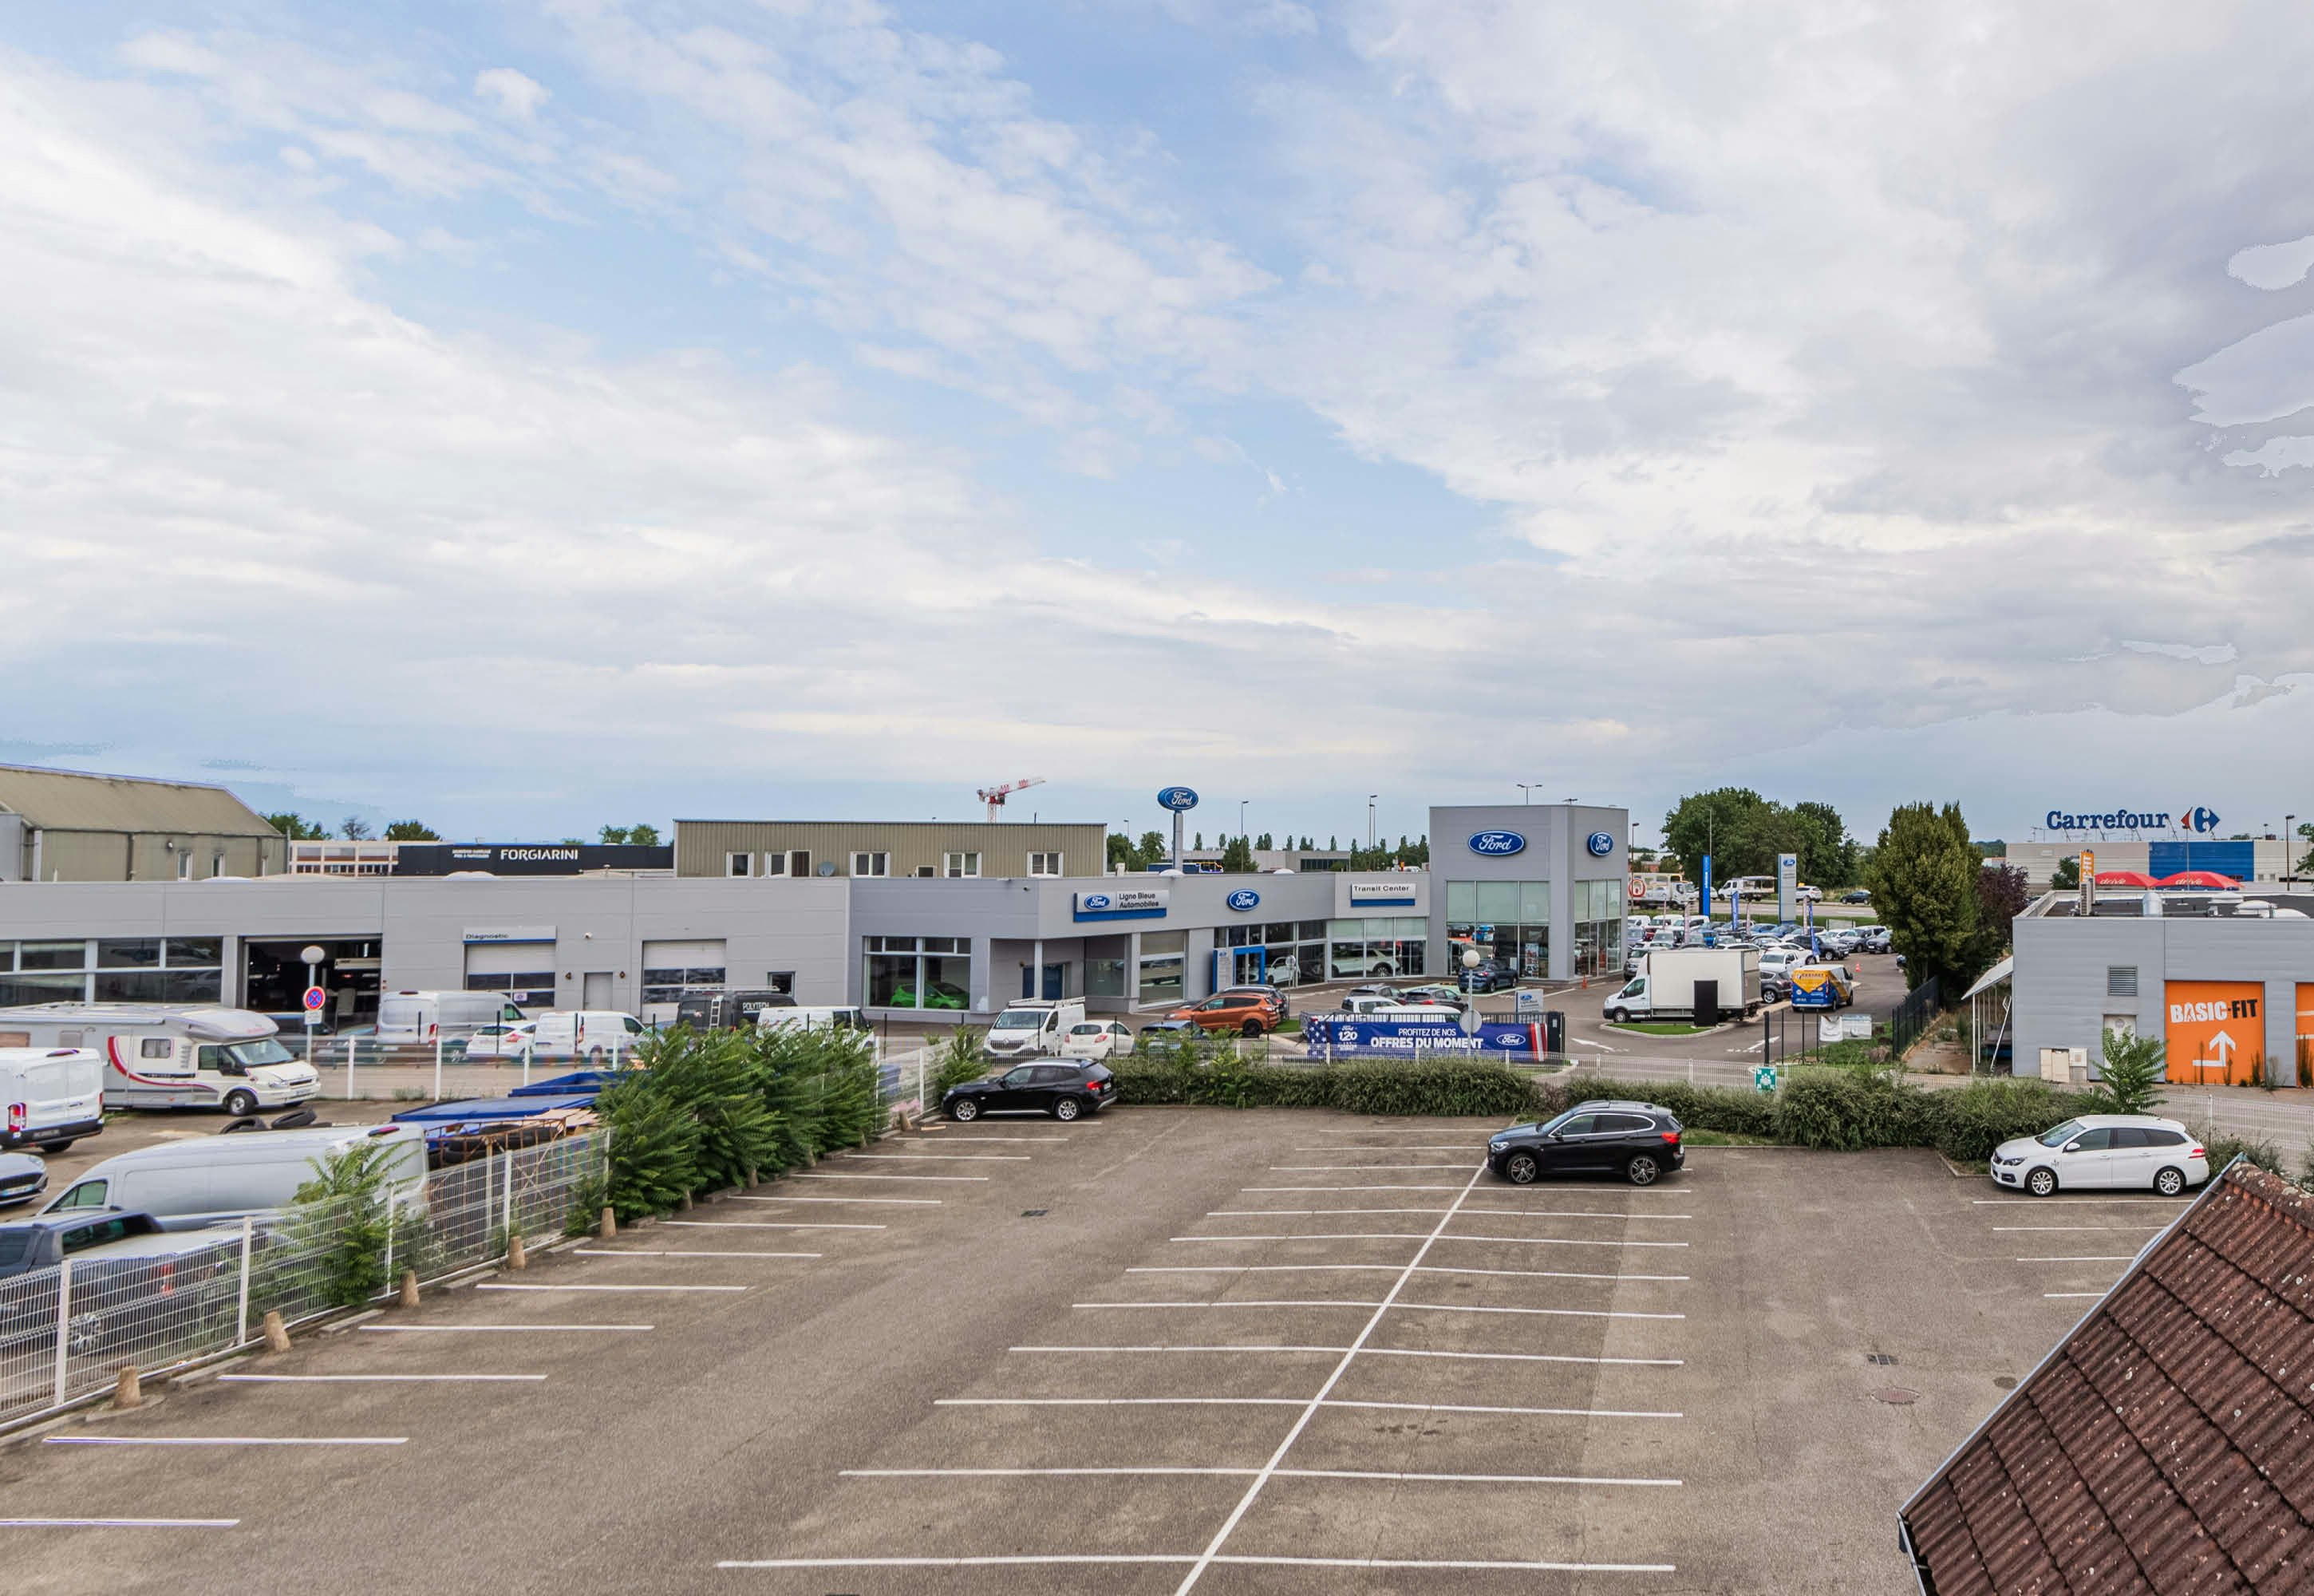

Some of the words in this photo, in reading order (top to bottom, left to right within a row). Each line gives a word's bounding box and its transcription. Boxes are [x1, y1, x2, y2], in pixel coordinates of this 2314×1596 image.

[1171, 791, 1193, 805] Ford
[2047, 809, 2169, 830] Carrefour
[1479, 834, 1512, 851] Ford
[1595, 835, 1610, 851] Ford
[500, 849, 578, 860] FORGIARINI
[1090, 897, 1106, 907] Ford
[1119, 893, 1136, 902] Ligne
[1236, 892, 1255, 907] Ford
[1119, 900, 1159, 909] Automobiles
[742, 1001, 770, 1010] POLYTECH
[2170, 999, 2257, 1024] BASIC-FIT
[1338, 1031, 1358, 1041] 120
[1398, 1028, 1430, 1037] PROFITEZ
[1371, 1037, 1414, 1049] OFFRES
[1416, 1037, 1432, 1049] DU
[1434, 1037, 1484, 1049] MOMENT
[1502, 1034, 1521, 1044] Ford
